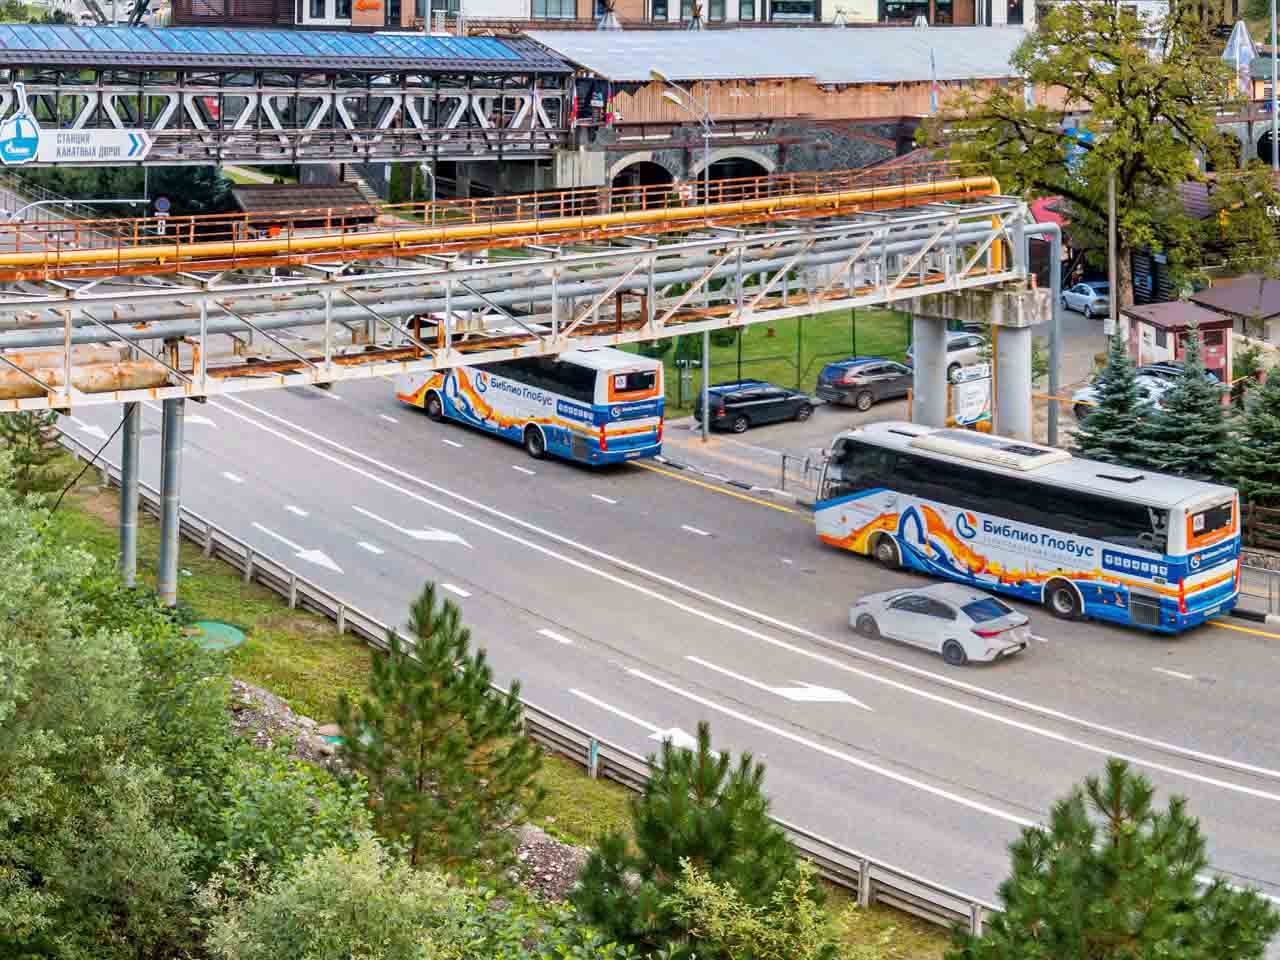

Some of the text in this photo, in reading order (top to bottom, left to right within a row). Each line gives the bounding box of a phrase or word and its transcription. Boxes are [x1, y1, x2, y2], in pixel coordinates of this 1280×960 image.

[56, 146, 96, 157] КАНАТНЫХ
[490, 377, 553, 406] Библио Глобус
[983, 519, 1039, 544] Библио
[1040, 534, 1094, 557] Глобус
